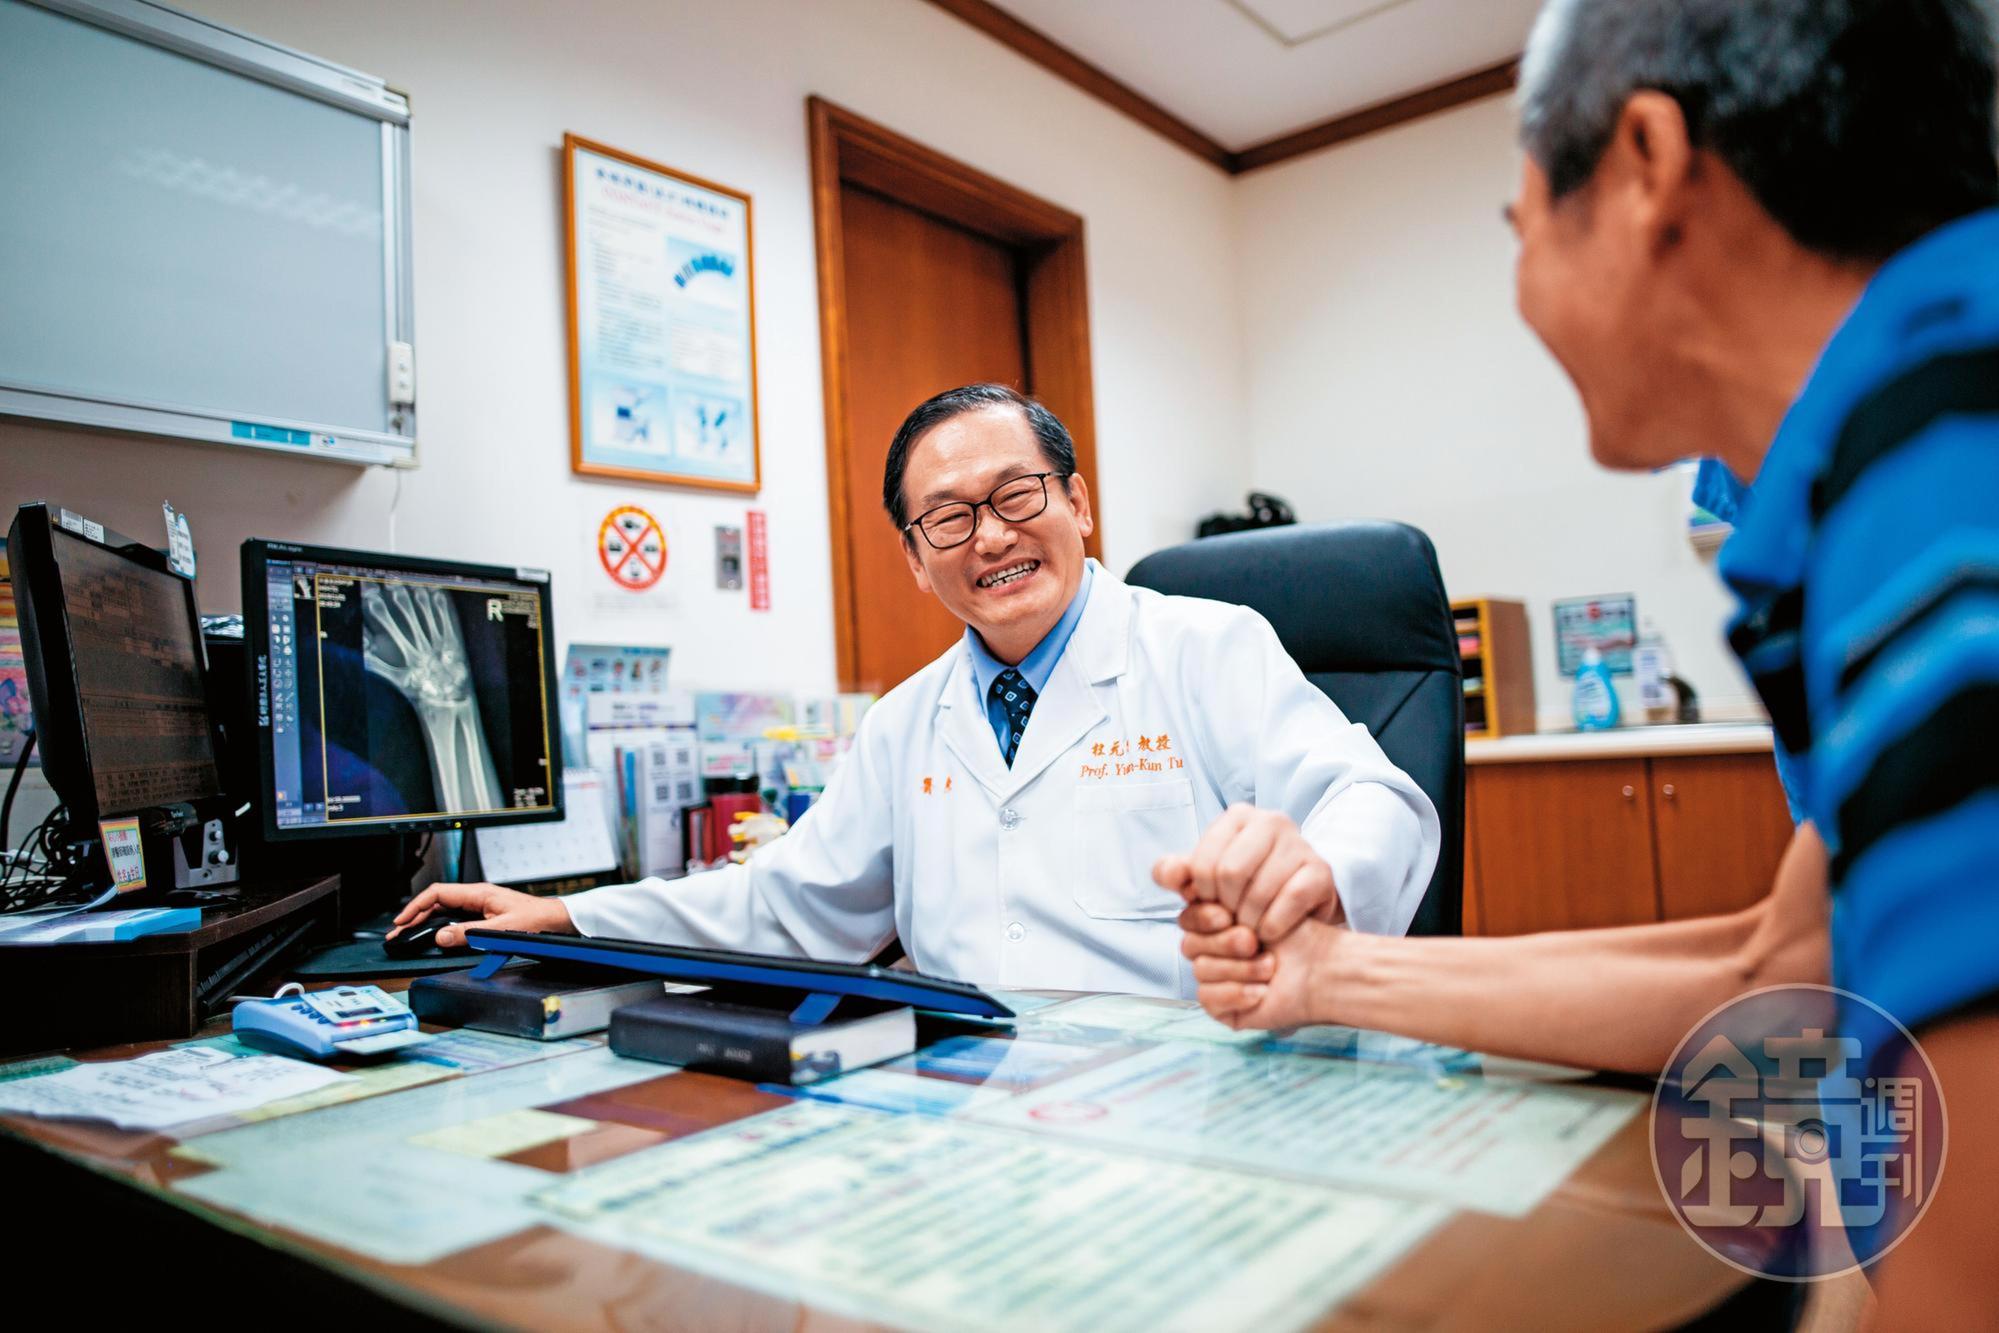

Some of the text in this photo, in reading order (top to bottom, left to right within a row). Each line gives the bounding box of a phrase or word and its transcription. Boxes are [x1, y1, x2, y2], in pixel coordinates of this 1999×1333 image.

[486, 598, 504, 622] R
[1080, 763, 1109, 779] Prof.
[1168, 756, 1183, 769] Tu
